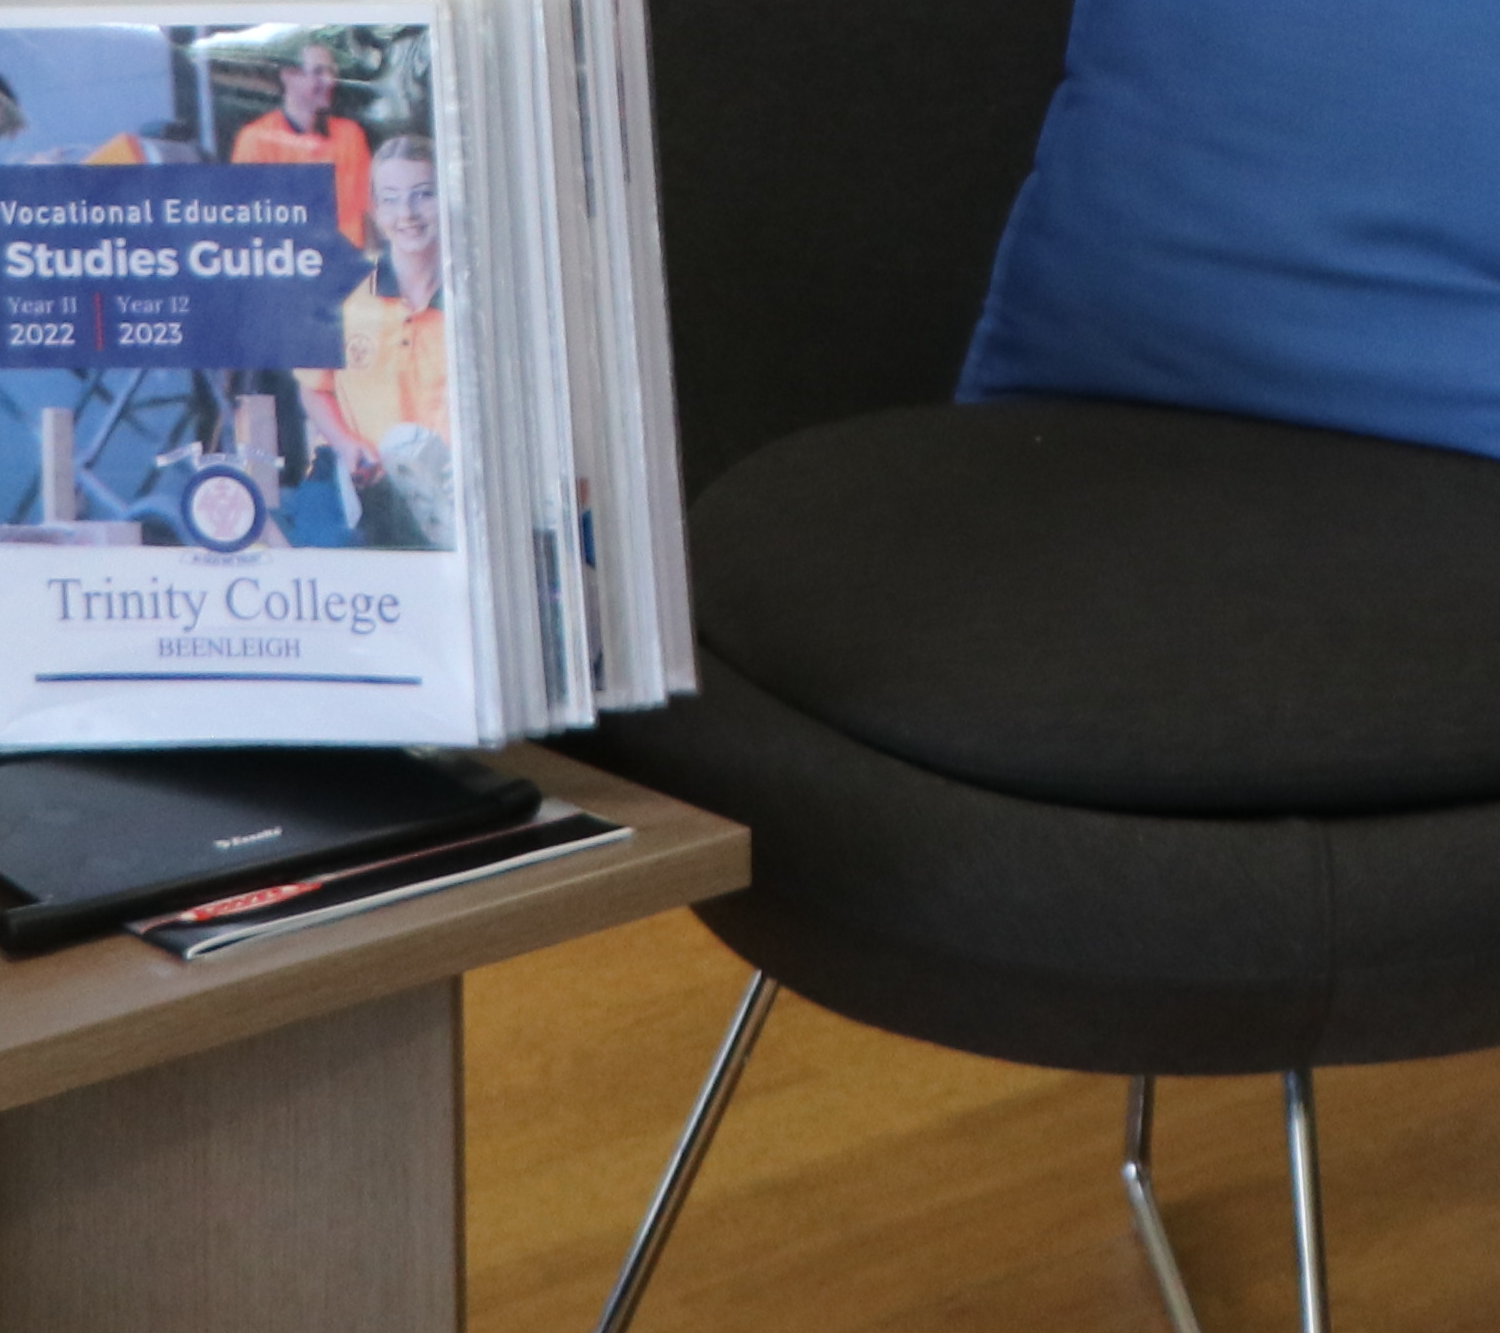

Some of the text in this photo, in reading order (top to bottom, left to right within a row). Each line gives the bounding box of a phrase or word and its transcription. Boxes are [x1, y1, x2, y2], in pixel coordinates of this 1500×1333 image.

[0, 199, 307, 225] Vocational Education
[5, 239, 322, 277] Studies Guide
[8, 296, 76, 313] Year 11
[116, 296, 190, 313] Year 12
[10, 324, 75, 345] 2022
[119, 323, 183, 344] 2023
[48, 576, 401, 633] Trinity College
[158, 637, 300, 658] BEENLEIGH
